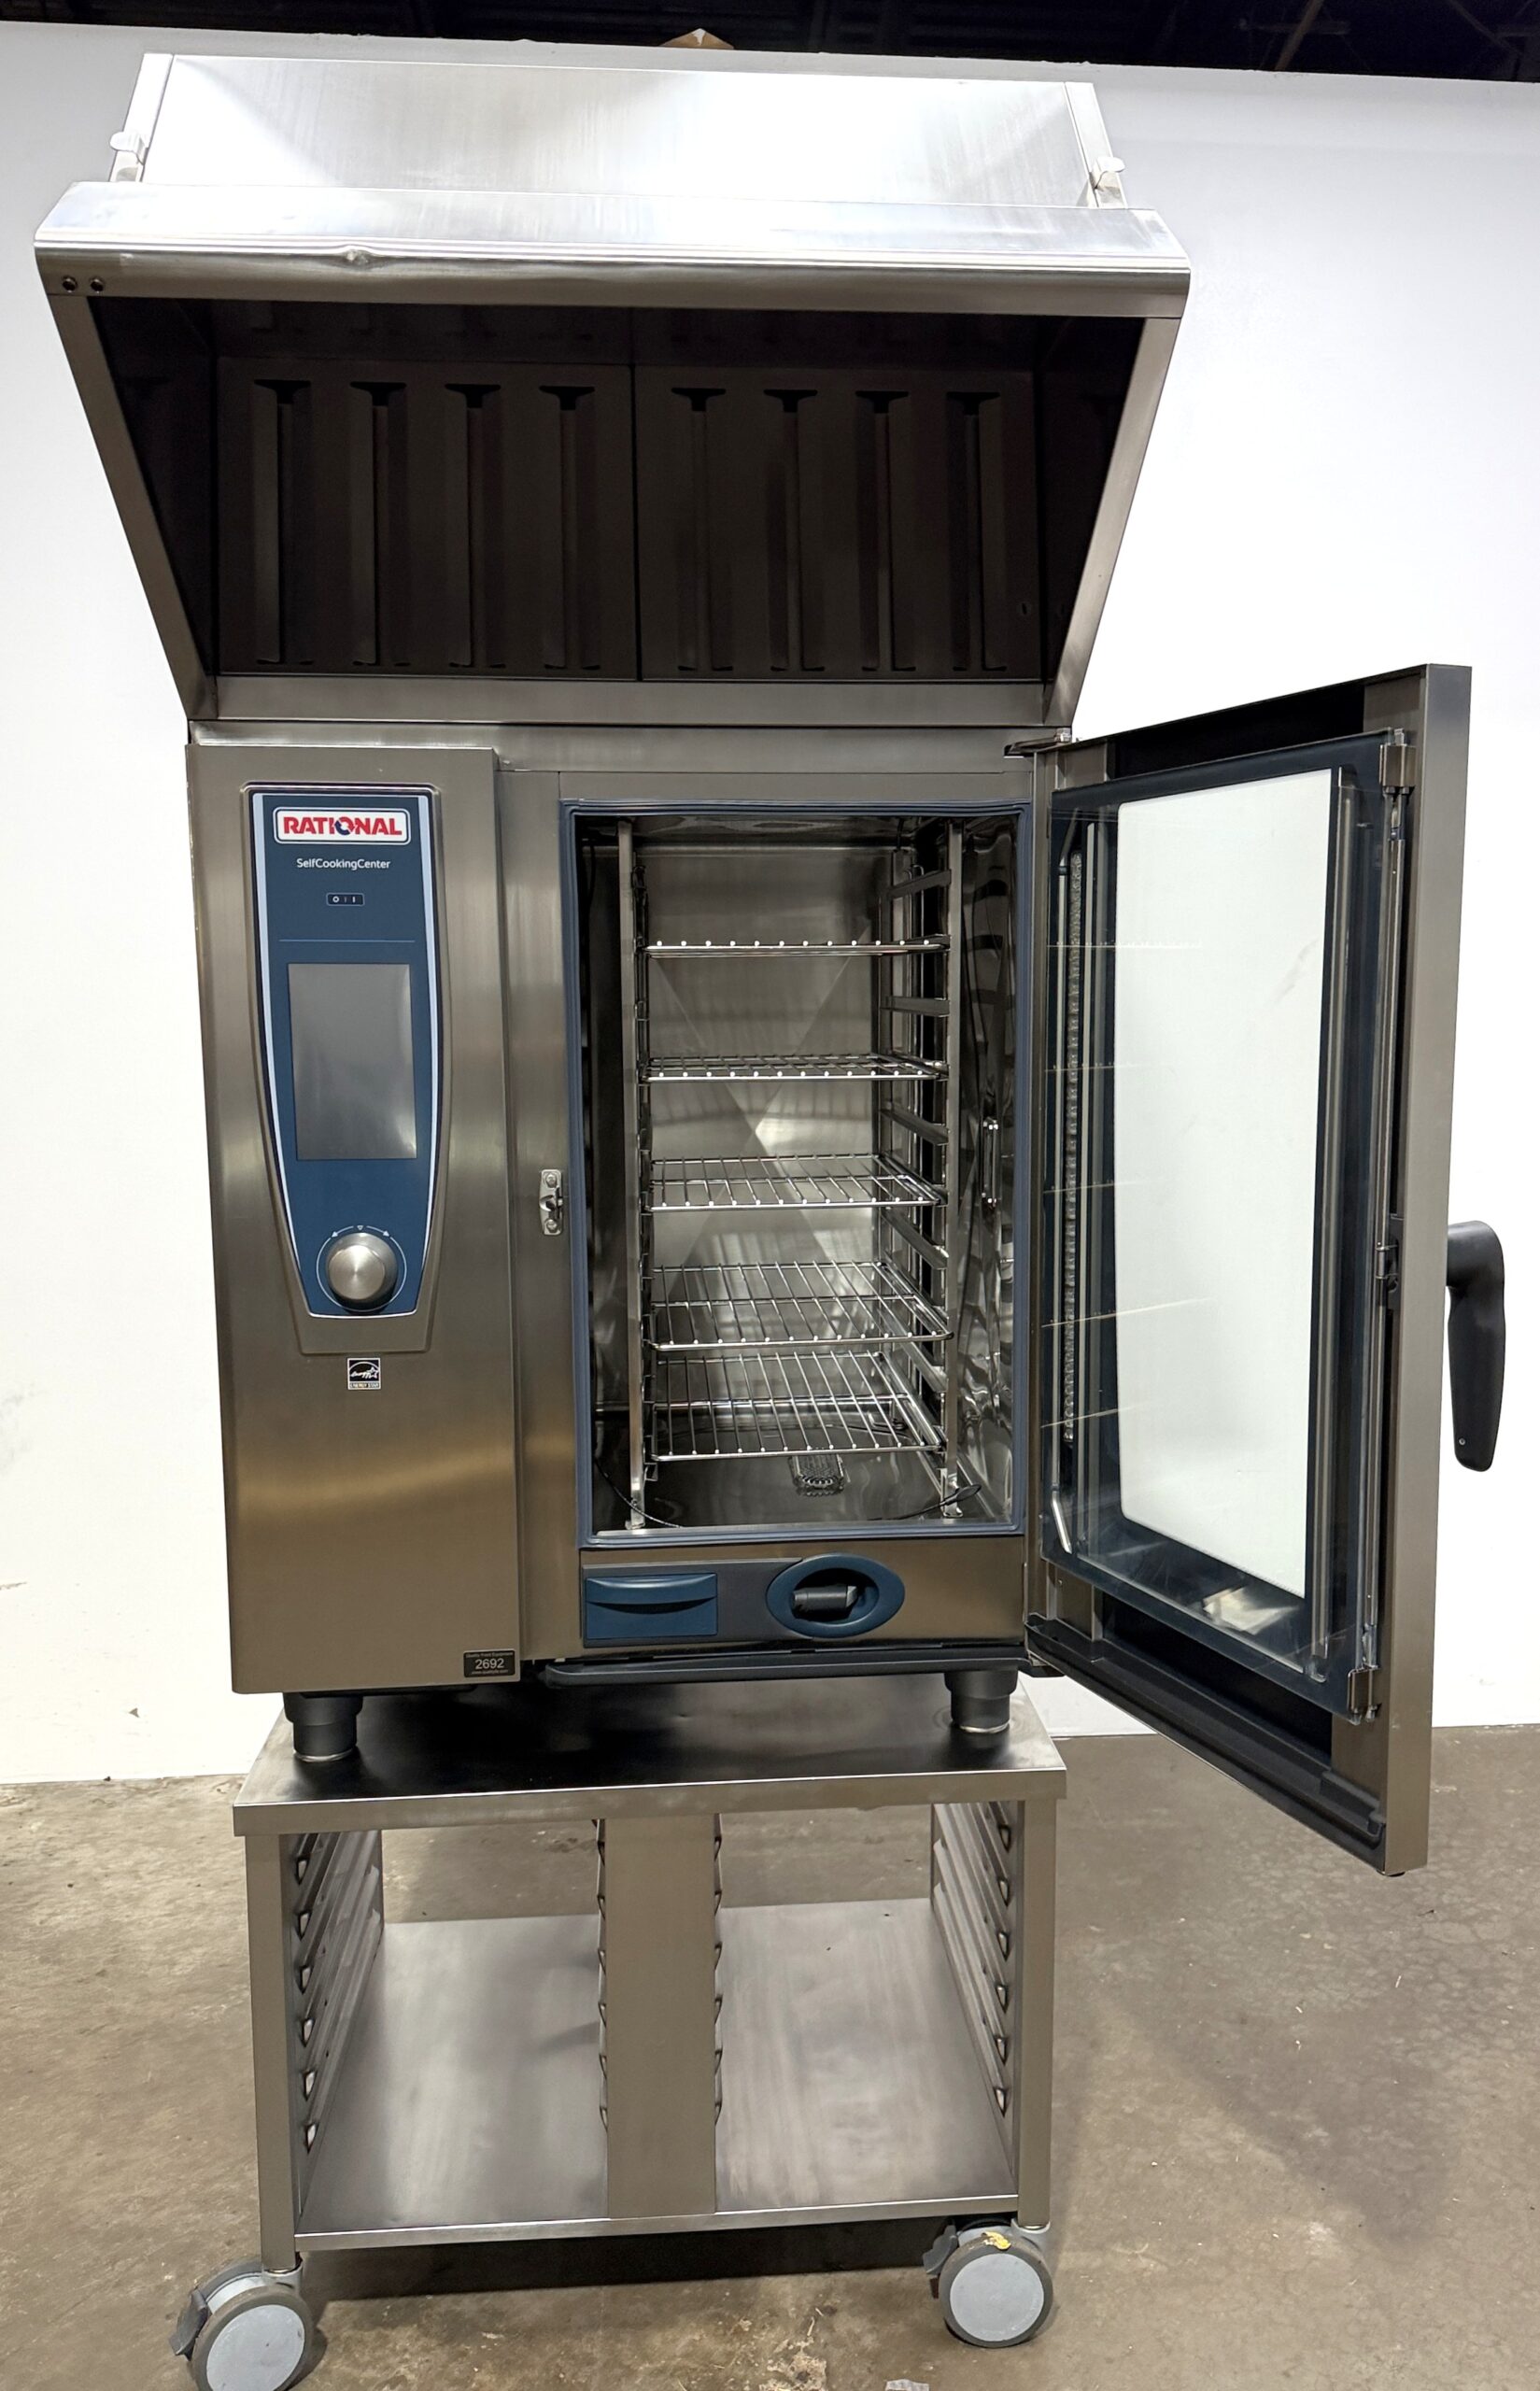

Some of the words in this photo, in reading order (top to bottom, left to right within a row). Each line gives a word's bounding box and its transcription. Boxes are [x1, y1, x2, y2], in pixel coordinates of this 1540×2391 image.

[283, 816, 403, 836] RATIONAL
[296, 857, 390, 870] SelfCookingCenter
[475, 1658, 504, 1670] 2692
